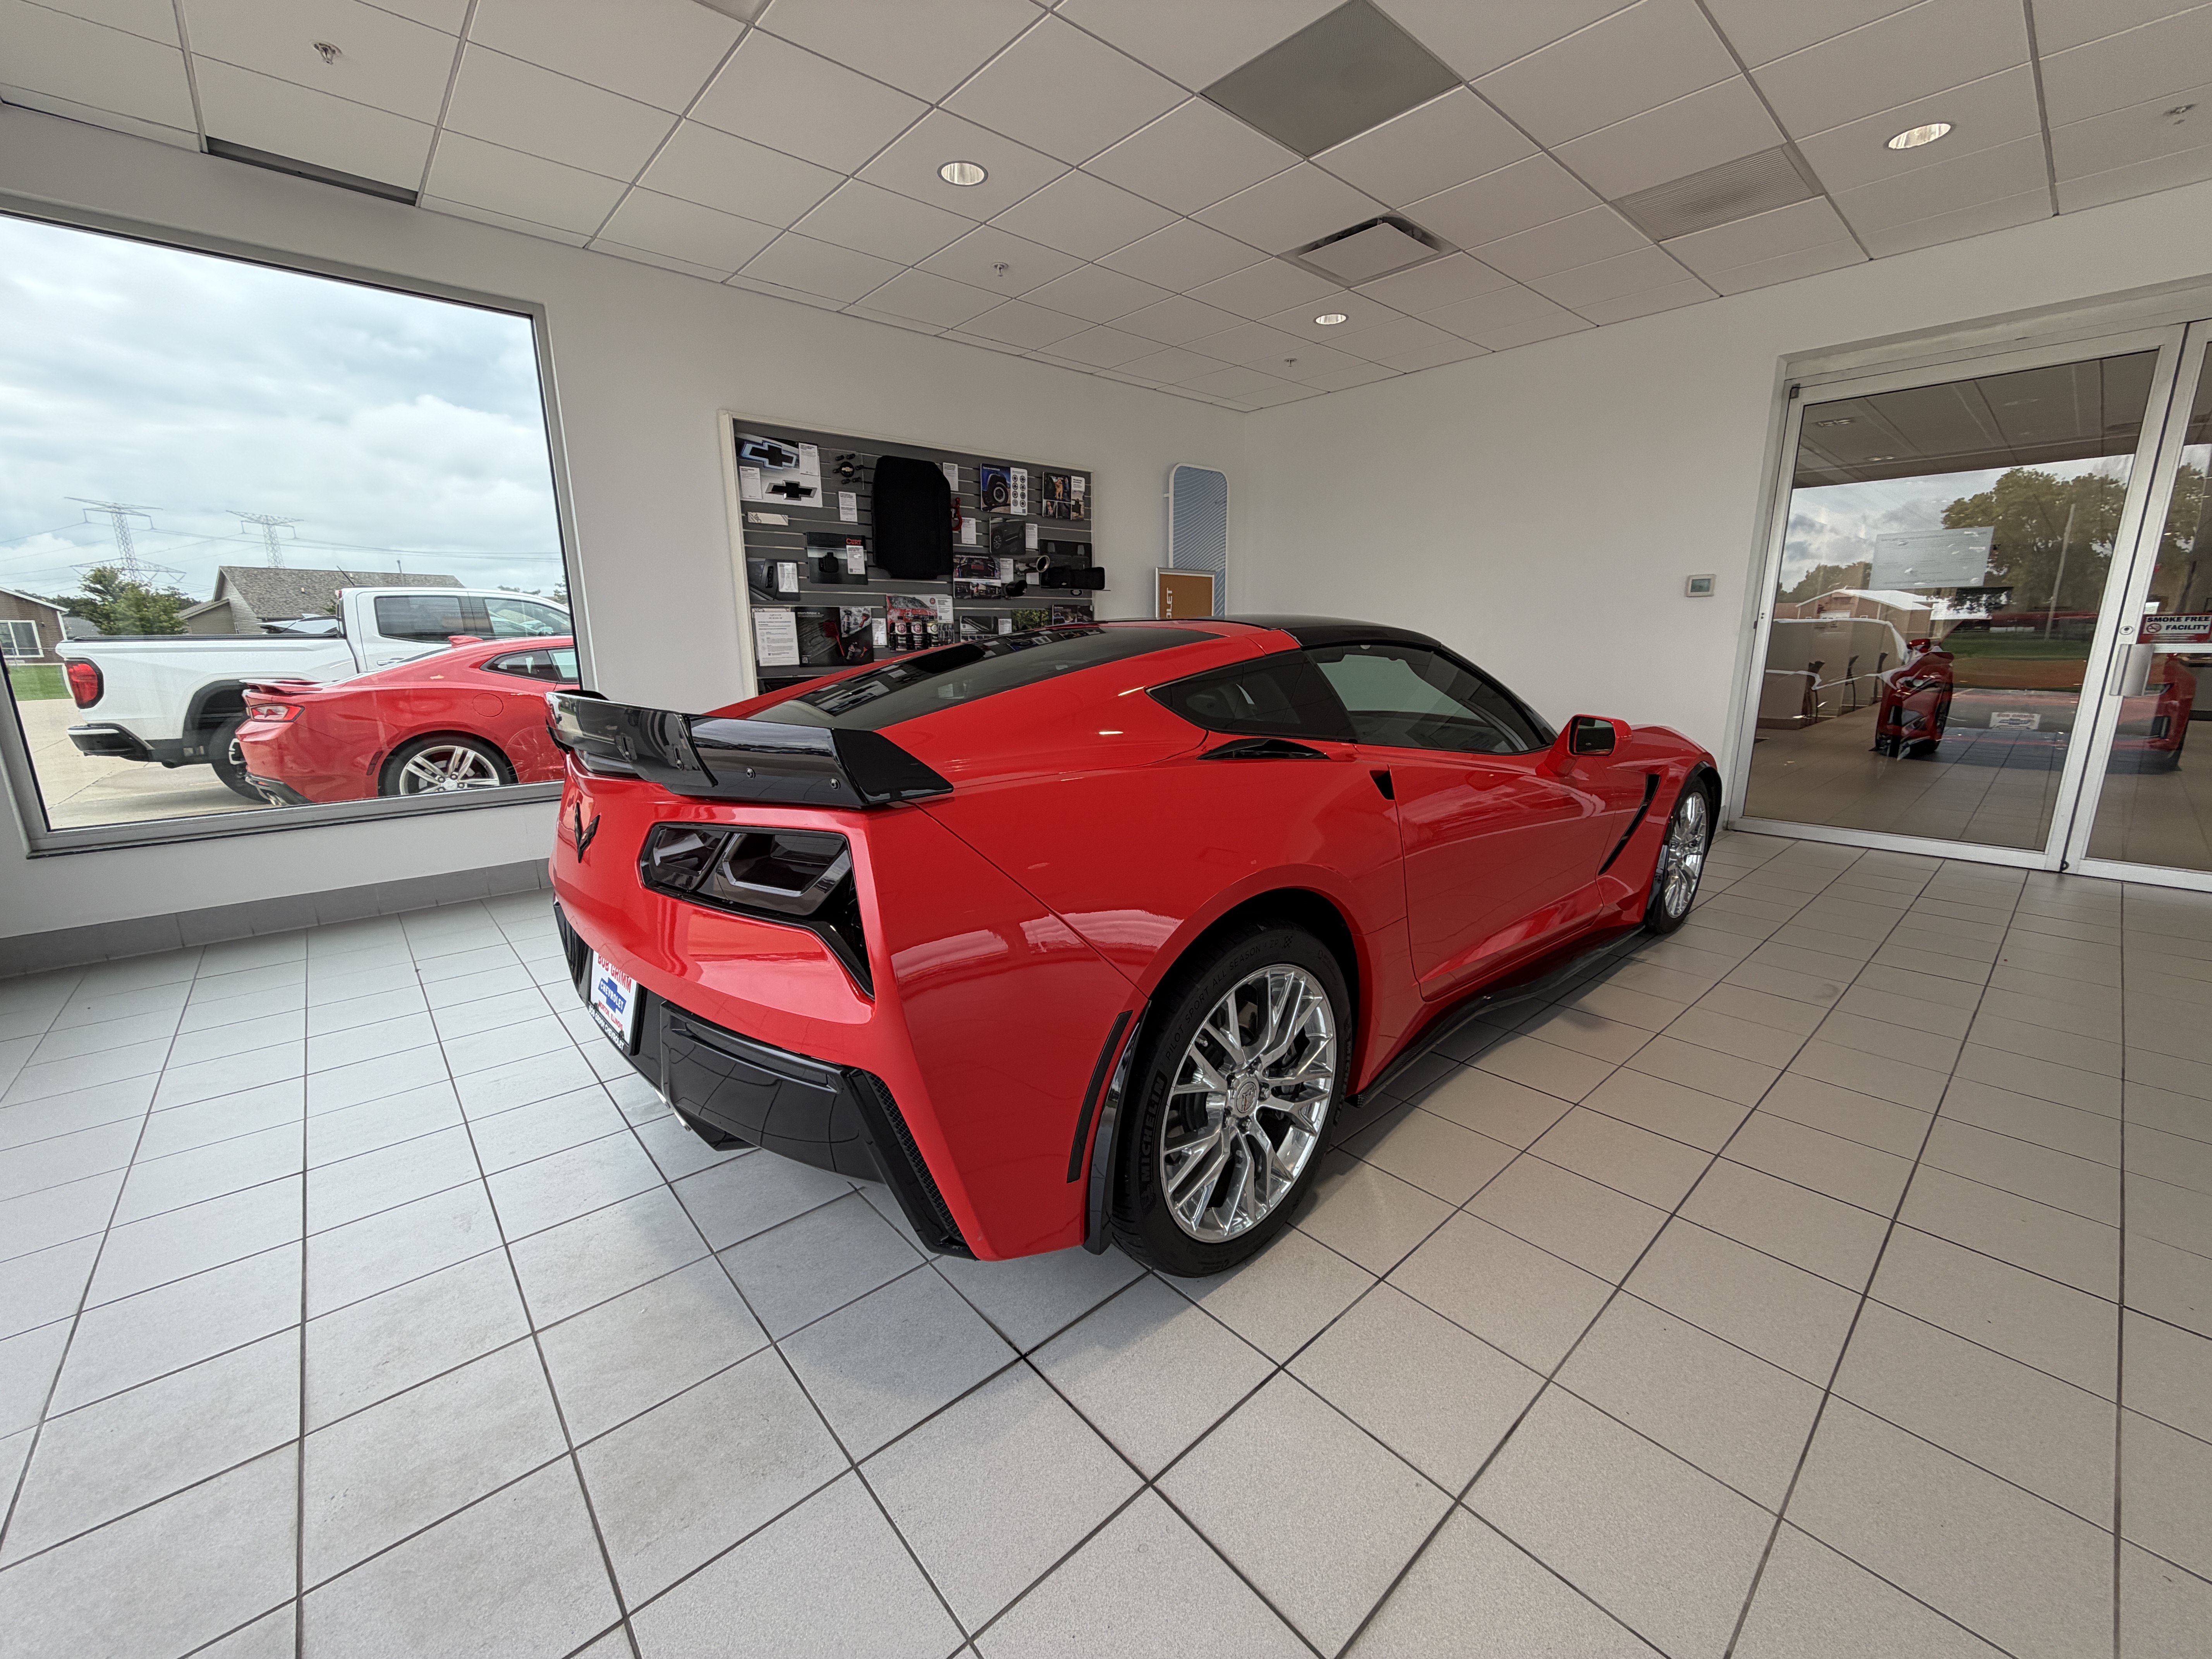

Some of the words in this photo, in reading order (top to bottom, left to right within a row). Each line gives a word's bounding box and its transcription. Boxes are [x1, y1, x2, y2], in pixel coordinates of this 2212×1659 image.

[598, 954, 609, 972] BOB
[611, 963, 632, 994] GRIMM
[600, 981, 624, 1010] CHEVROLET
[1166, 1024, 1184, 1061] PILOT
[1185, 986, 1209, 1024] SPORT
[1212, 969, 1227, 989] ALL
[1229, 946, 1261, 971] SEASON
[1270, 939, 1279, 948] ZP
[605, 1024, 624, 1051] CHEVROLET
[1141, 1076, 1165, 1183] MICHELIN
